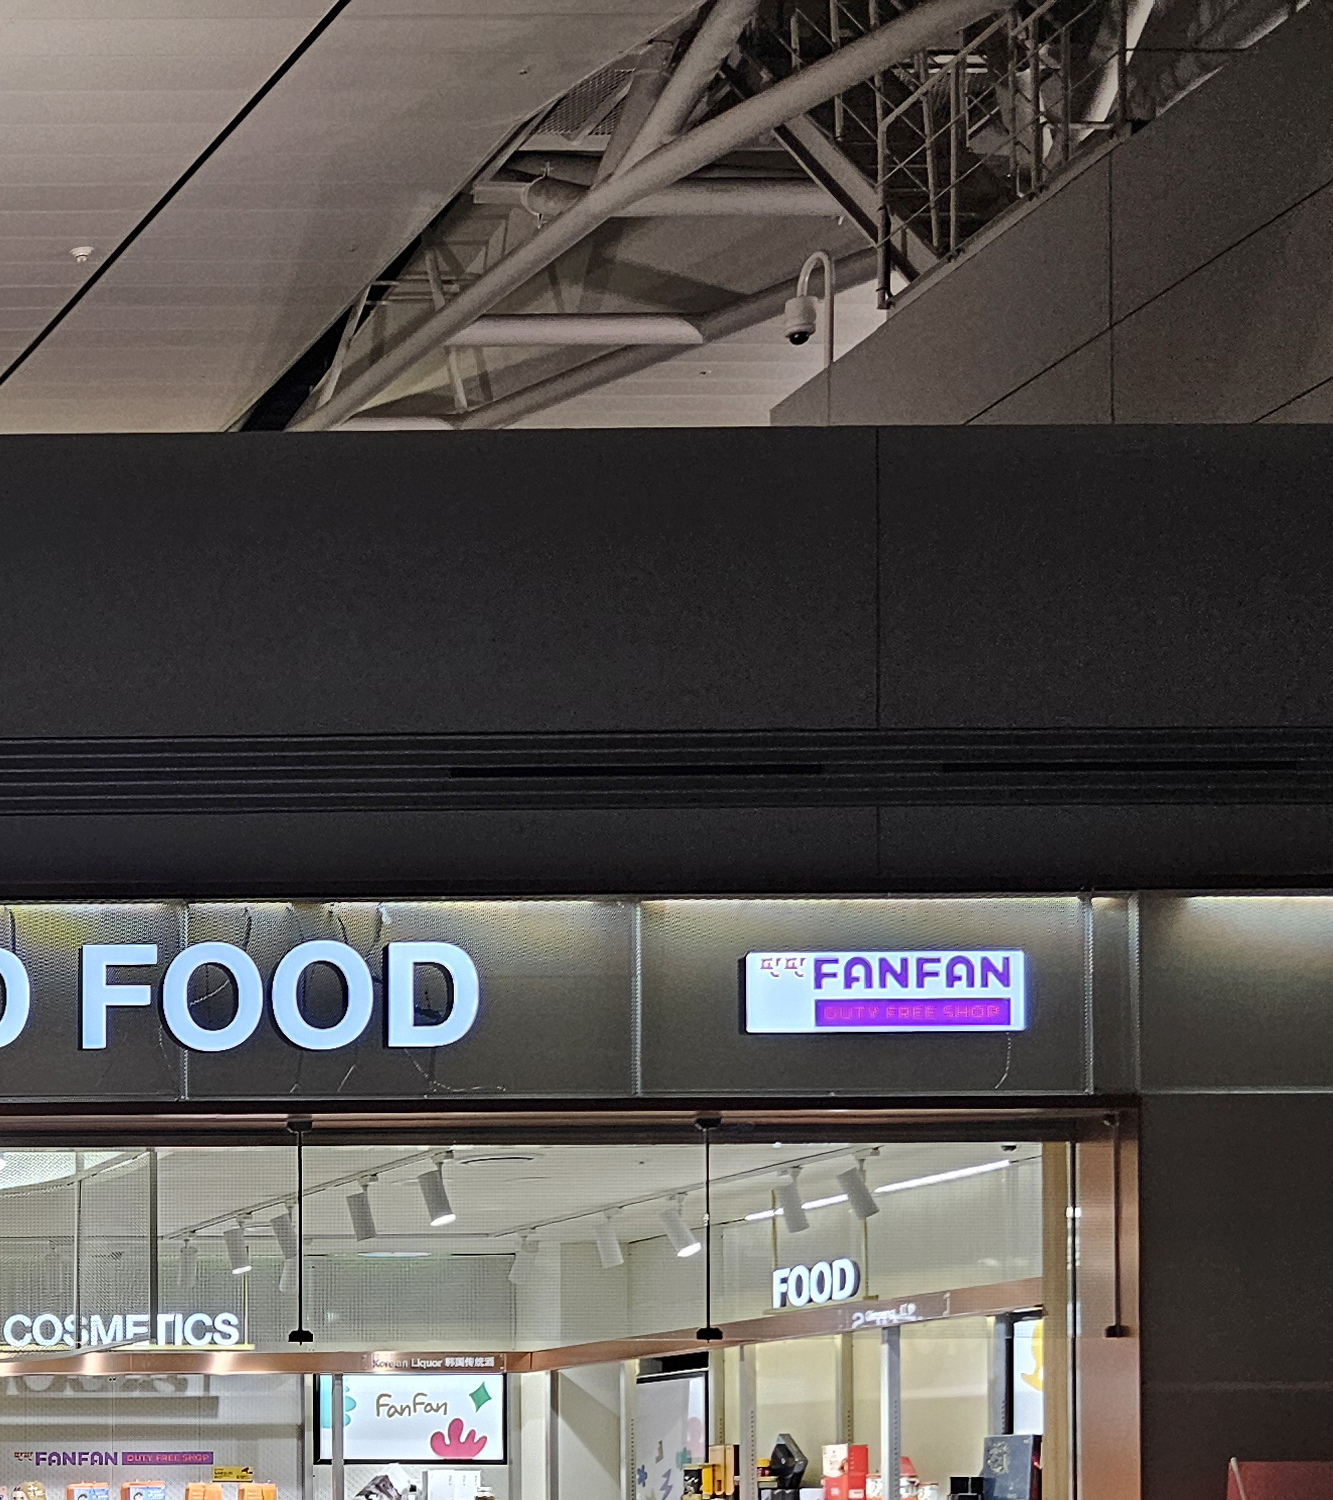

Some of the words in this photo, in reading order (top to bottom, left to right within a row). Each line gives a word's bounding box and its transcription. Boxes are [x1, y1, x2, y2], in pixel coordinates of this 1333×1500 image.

[813, 955, 1011, 990] FANFAN
[80, 941, 481, 1053] FOOD
[824, 1006, 879, 1020] DUTY
[887, 1006, 937, 1020] FREE
[943, 1006, 1001, 1020] SHOP
[772, 1258, 857, 1309] FOOD
[3, 1312, 240, 1347] COSMETICS
[372, 1358, 408, 1368] Korean
[411, 1357, 443, 1369] Liquor
[375, 1392, 449, 1418] FanFan
[35, 1452, 118, 1466] FANFAN
[126, 1454, 152, 1462] DUTY
[156, 1454, 179, 1462] FREE
